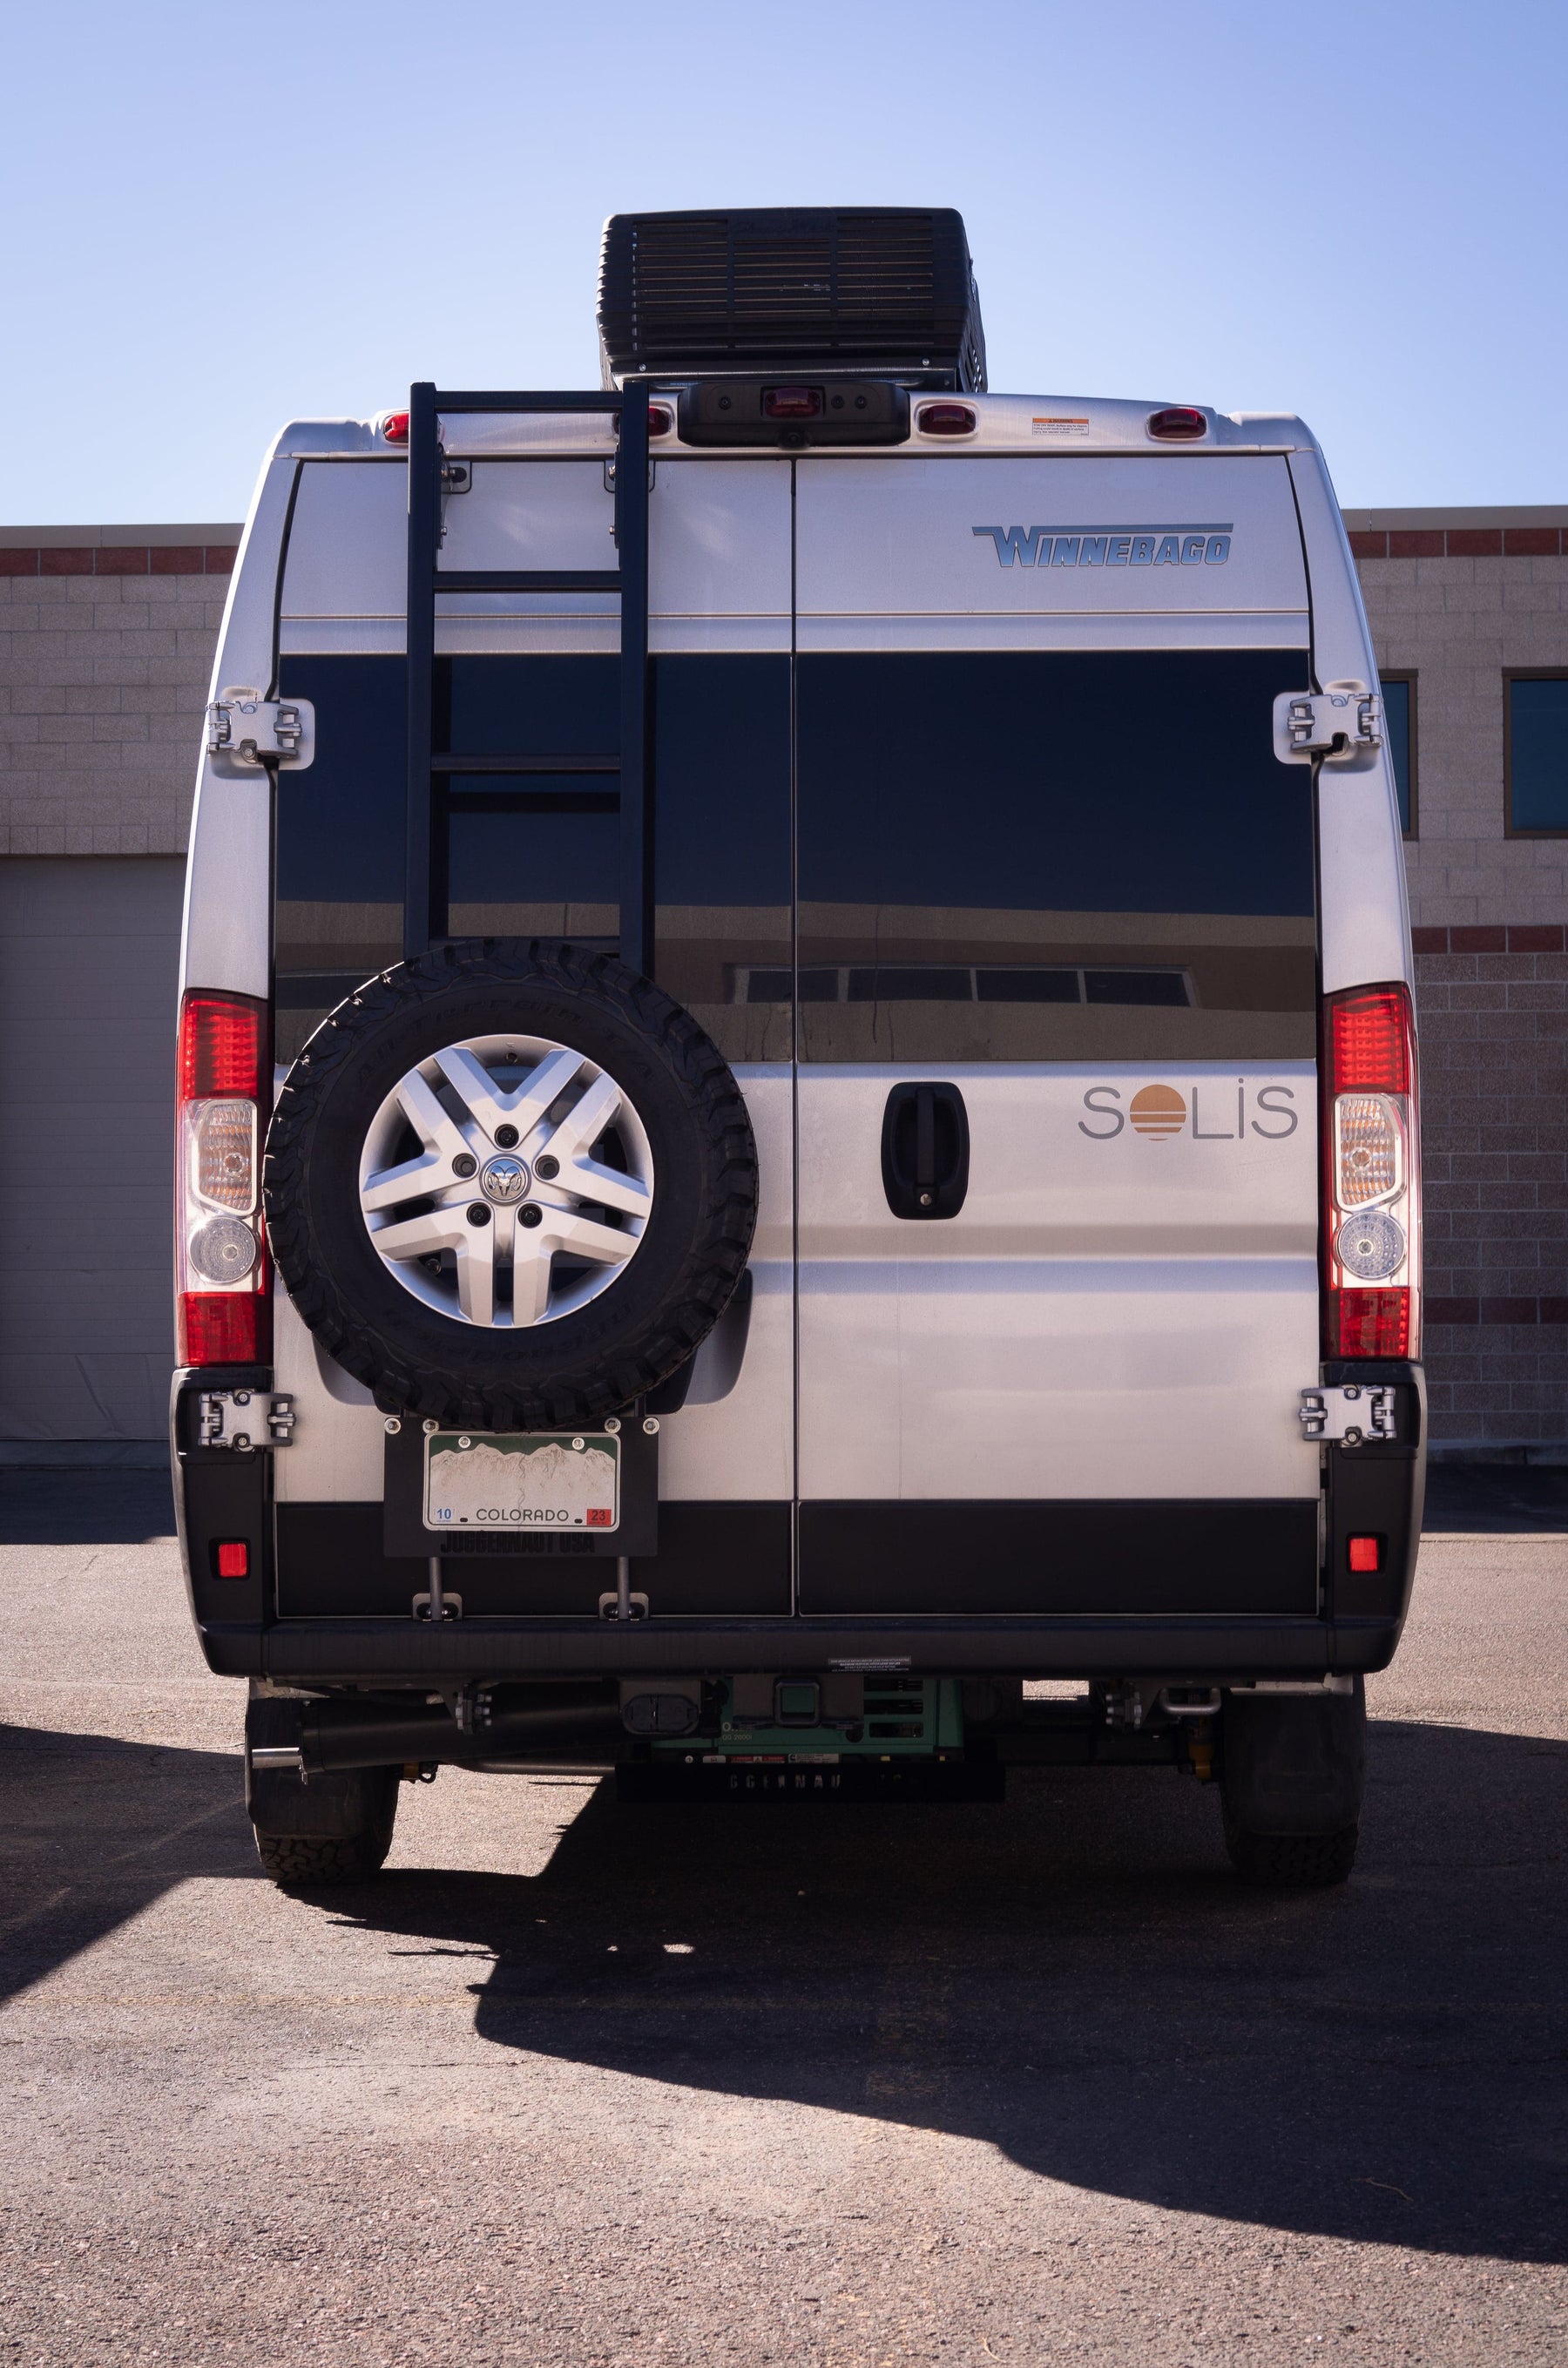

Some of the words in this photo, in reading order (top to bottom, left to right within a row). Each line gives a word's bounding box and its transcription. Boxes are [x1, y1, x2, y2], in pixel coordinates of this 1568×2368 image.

[971, 523, 1234, 568] WINNEBAGO
[436, 1508, 451, 1519] 10
[476, 1508, 569, 1522] COLORADO
[591, 1509, 606, 1521] 23
[440, 1531, 554, 1553] JUGGERNAUT
[558, 1531, 596, 1553] USA
